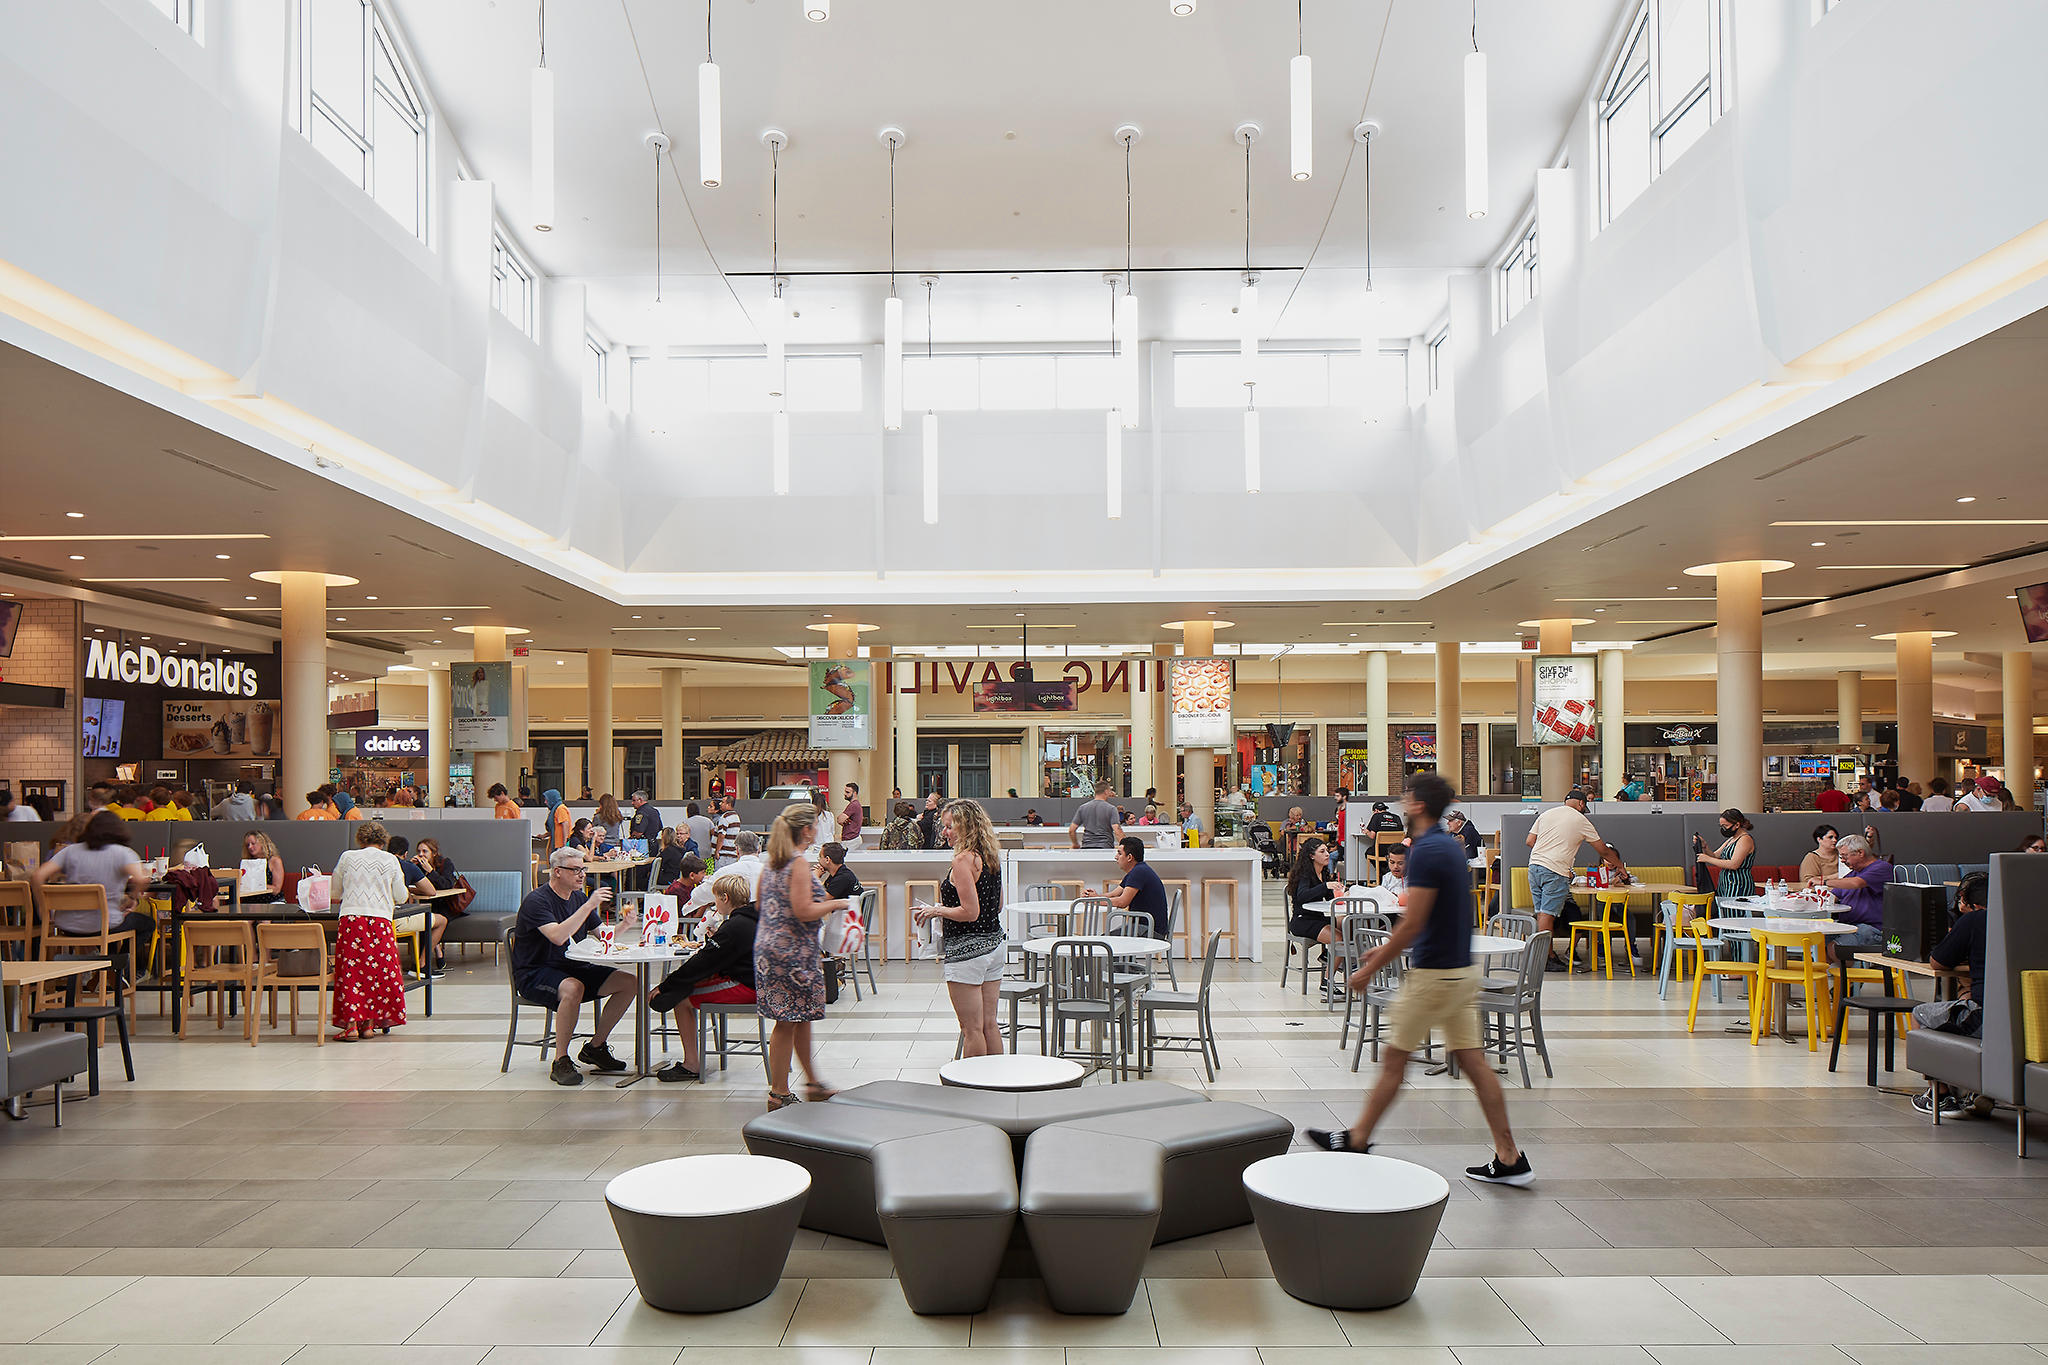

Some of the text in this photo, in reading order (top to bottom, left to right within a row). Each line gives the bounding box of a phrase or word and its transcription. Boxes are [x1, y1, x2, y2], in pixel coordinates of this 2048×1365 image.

[86, 638, 258, 697] McDonald's
[1539, 665, 1573, 673] GIVE THE
[1558, 671, 1569, 679] OF
[166, 703, 203, 714] Try Our
[166, 713, 212, 722] Desserts
[364, 735, 421, 752] claire's
